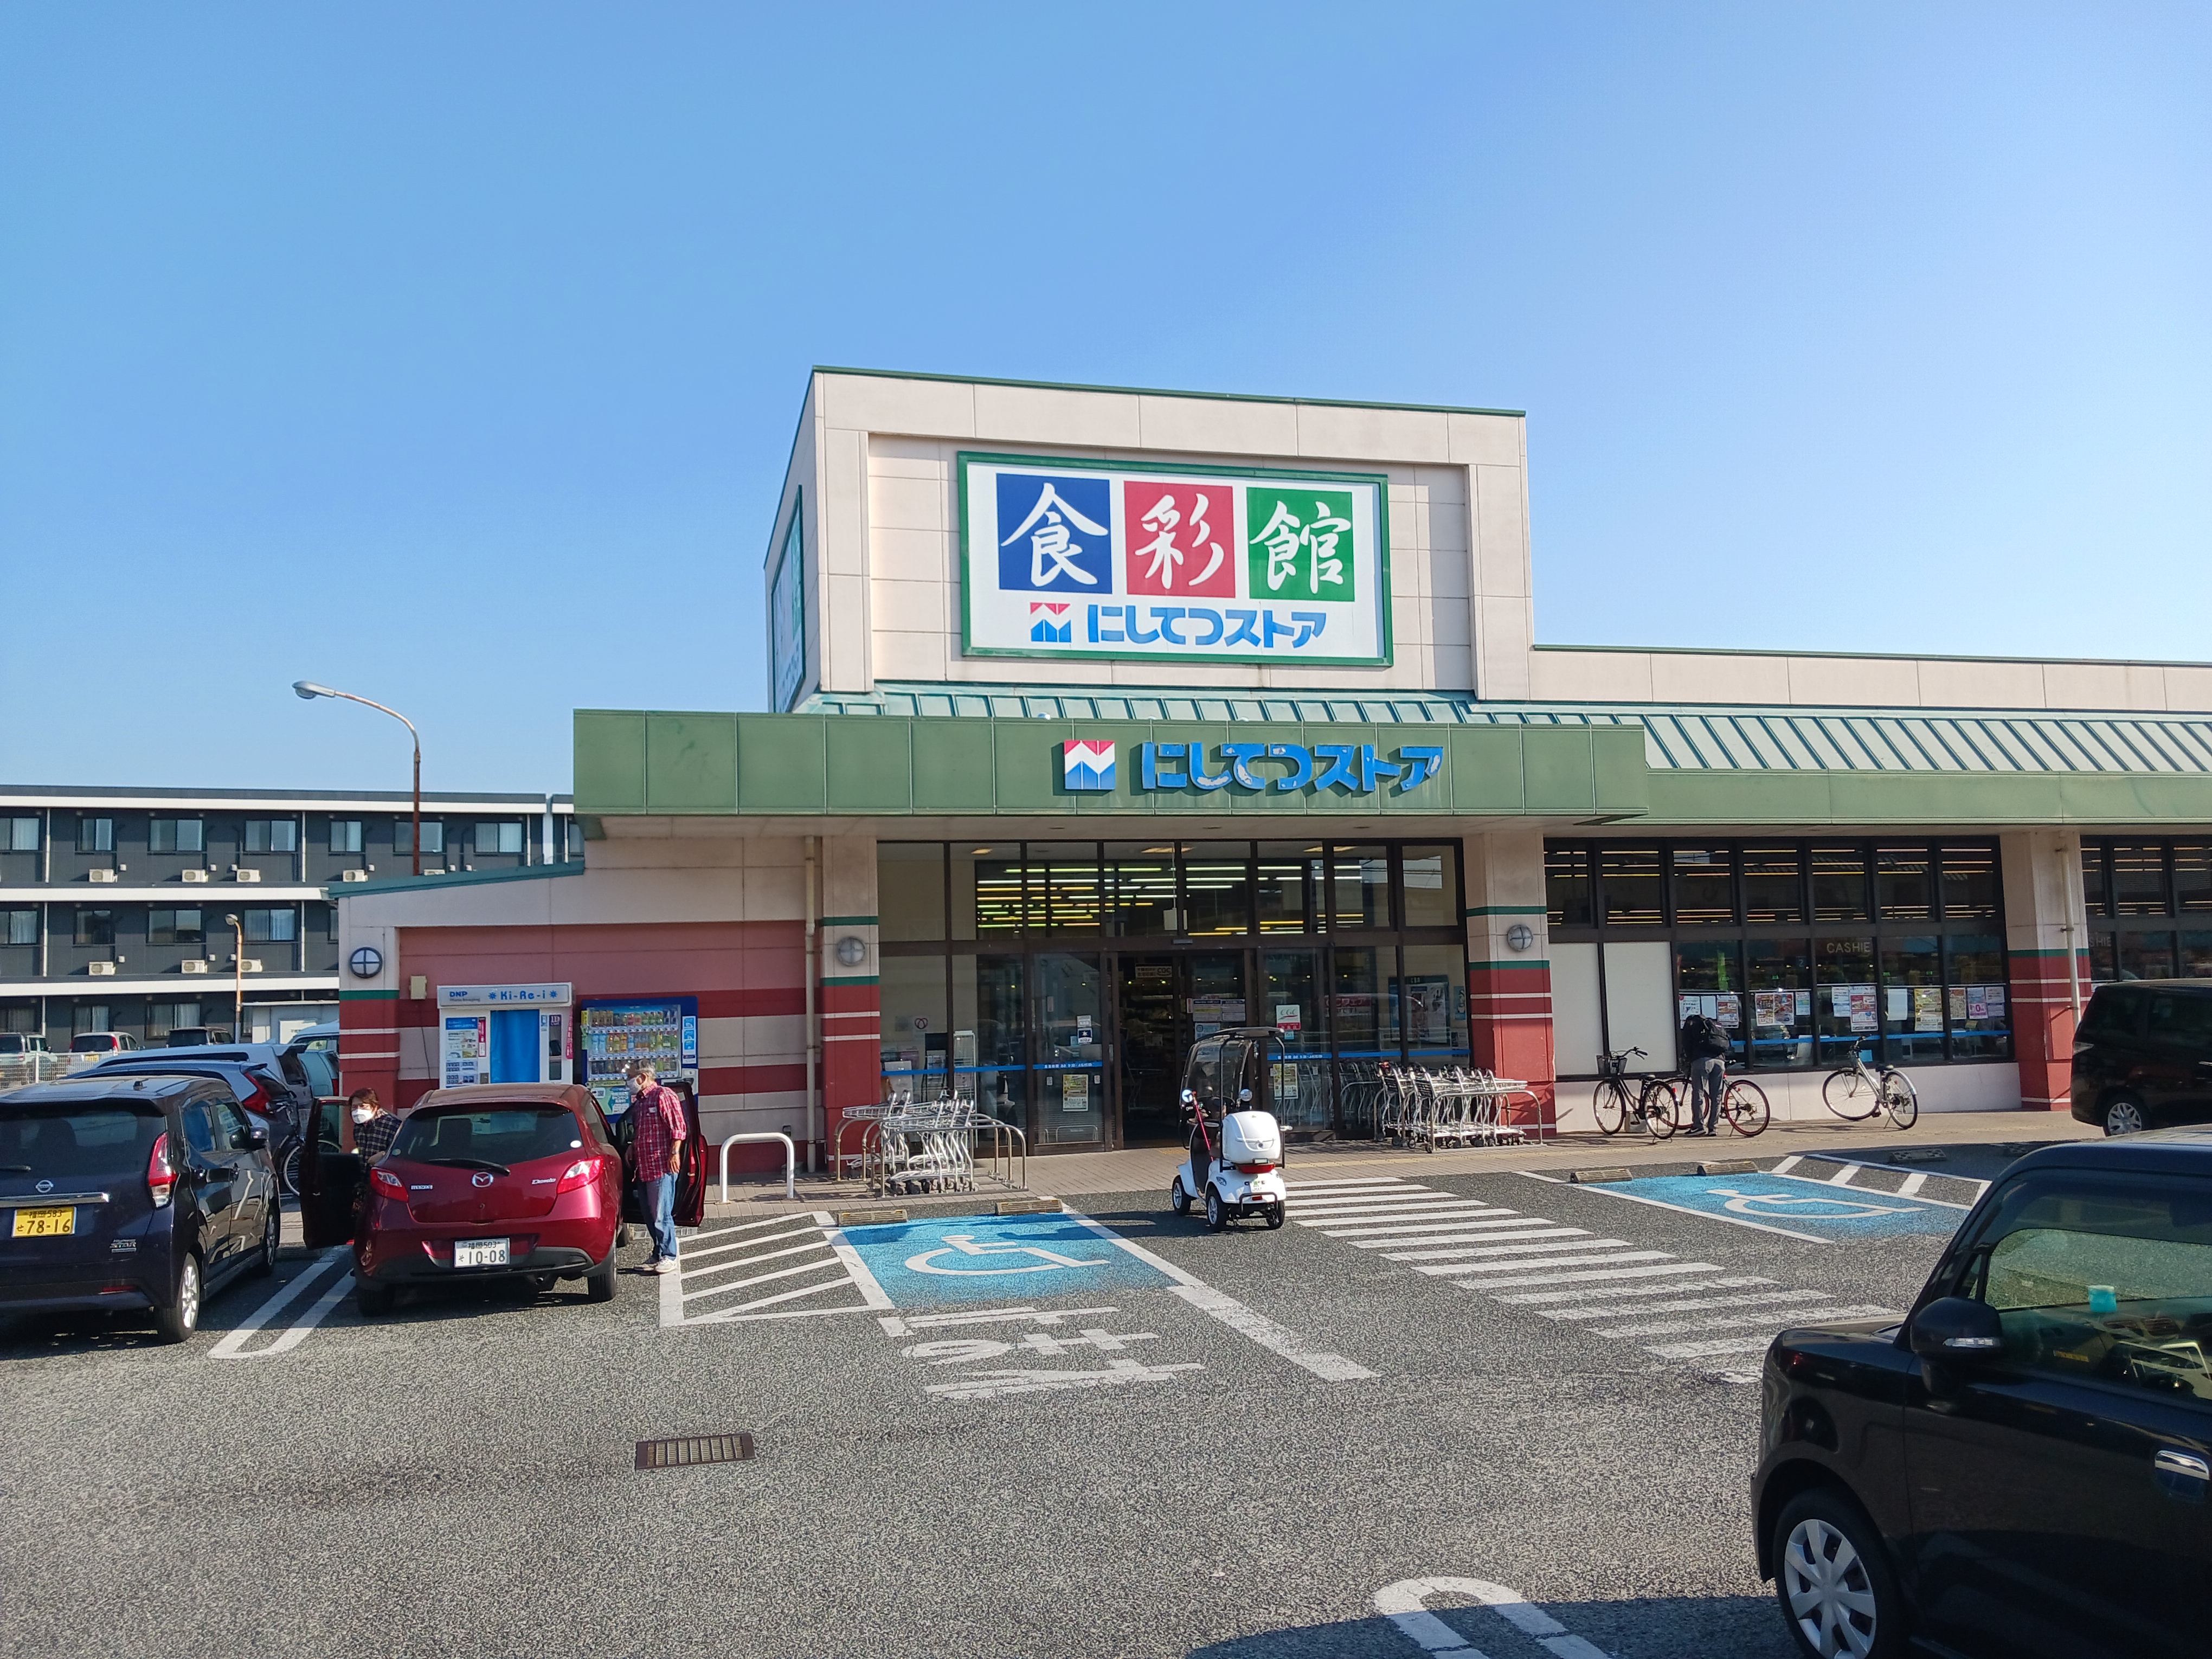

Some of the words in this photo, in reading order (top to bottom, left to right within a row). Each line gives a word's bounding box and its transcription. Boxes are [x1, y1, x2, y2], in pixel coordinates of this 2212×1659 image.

[1001, 482, 1352, 594] 食彩館
[1087, 604, 1327, 648] にしてつストア
[1141, 742, 1443, 792] にしてつストア
[1827, 942, 1871, 954] CASHIE
[27, 1219, 71, 1234] 78-16
[469, 1250, 505, 1264] 10-08
